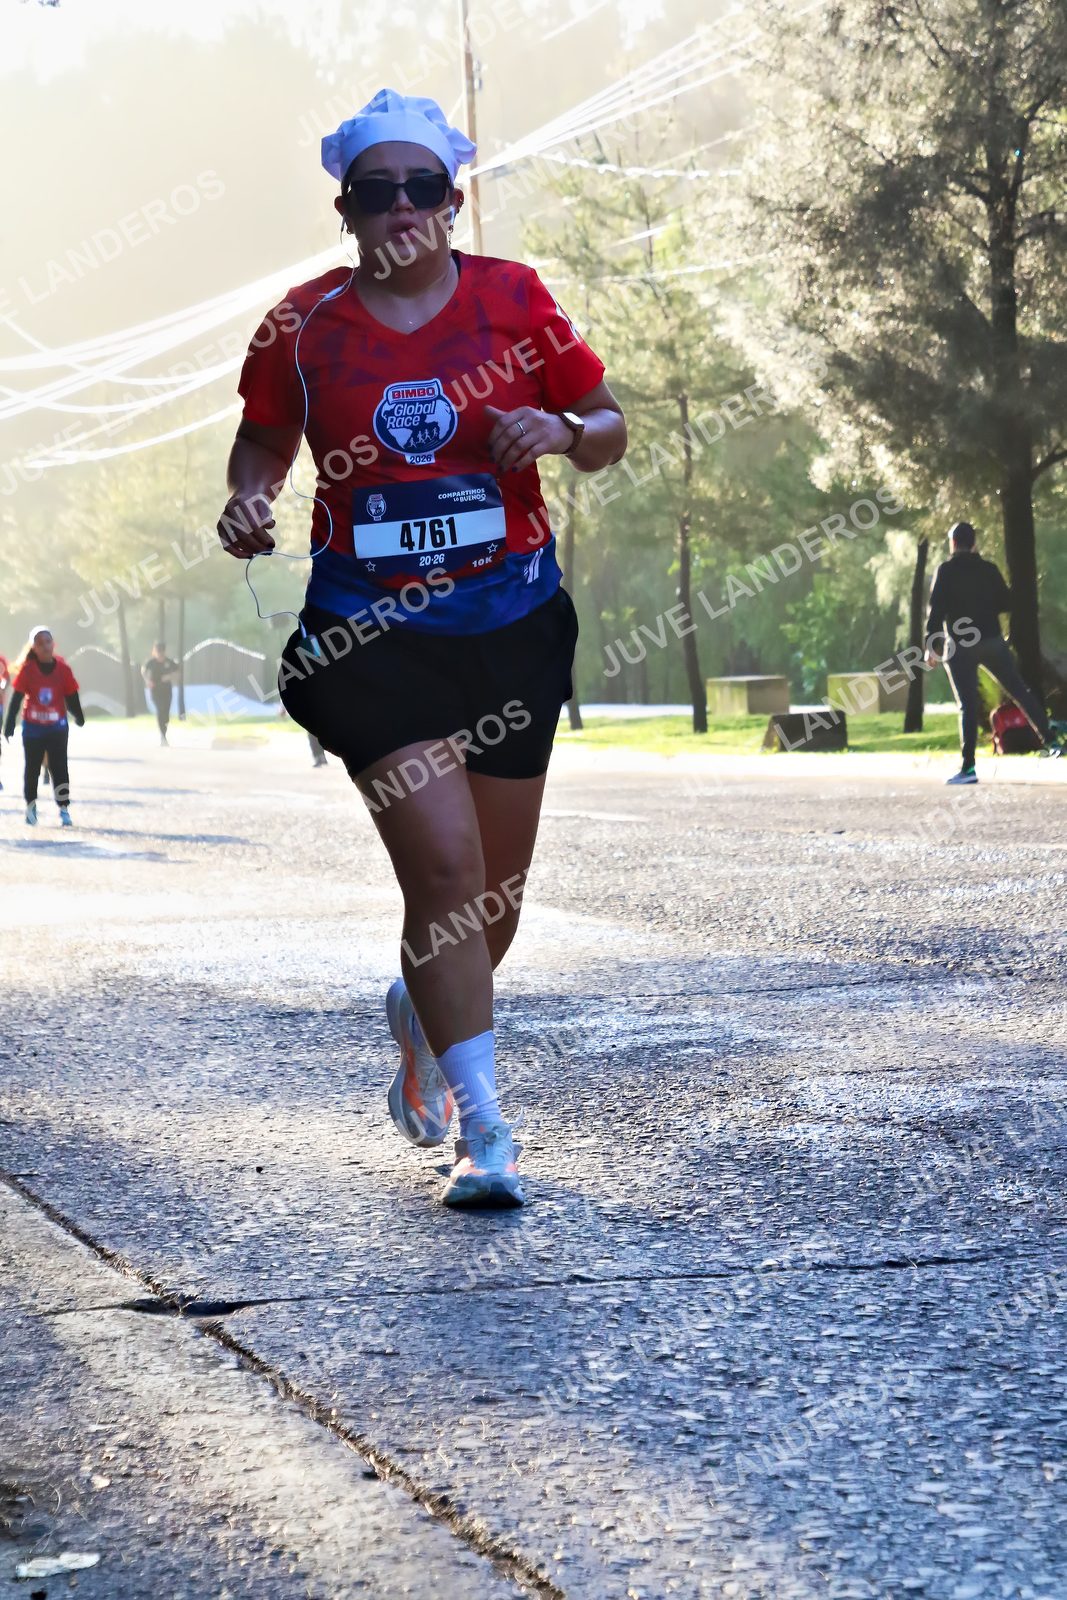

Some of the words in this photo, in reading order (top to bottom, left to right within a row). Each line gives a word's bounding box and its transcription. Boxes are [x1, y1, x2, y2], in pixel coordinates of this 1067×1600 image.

[392, 387, 435, 399] BIMBO
[394, 401, 435, 416] Global
[387, 416, 420, 429] Race
[410, 454, 433, 464] 2026
[438, 488, 485, 500] COMPARTIMOS
[400, 516, 458, 552] 4761
[472, 555, 493, 568] 10K
